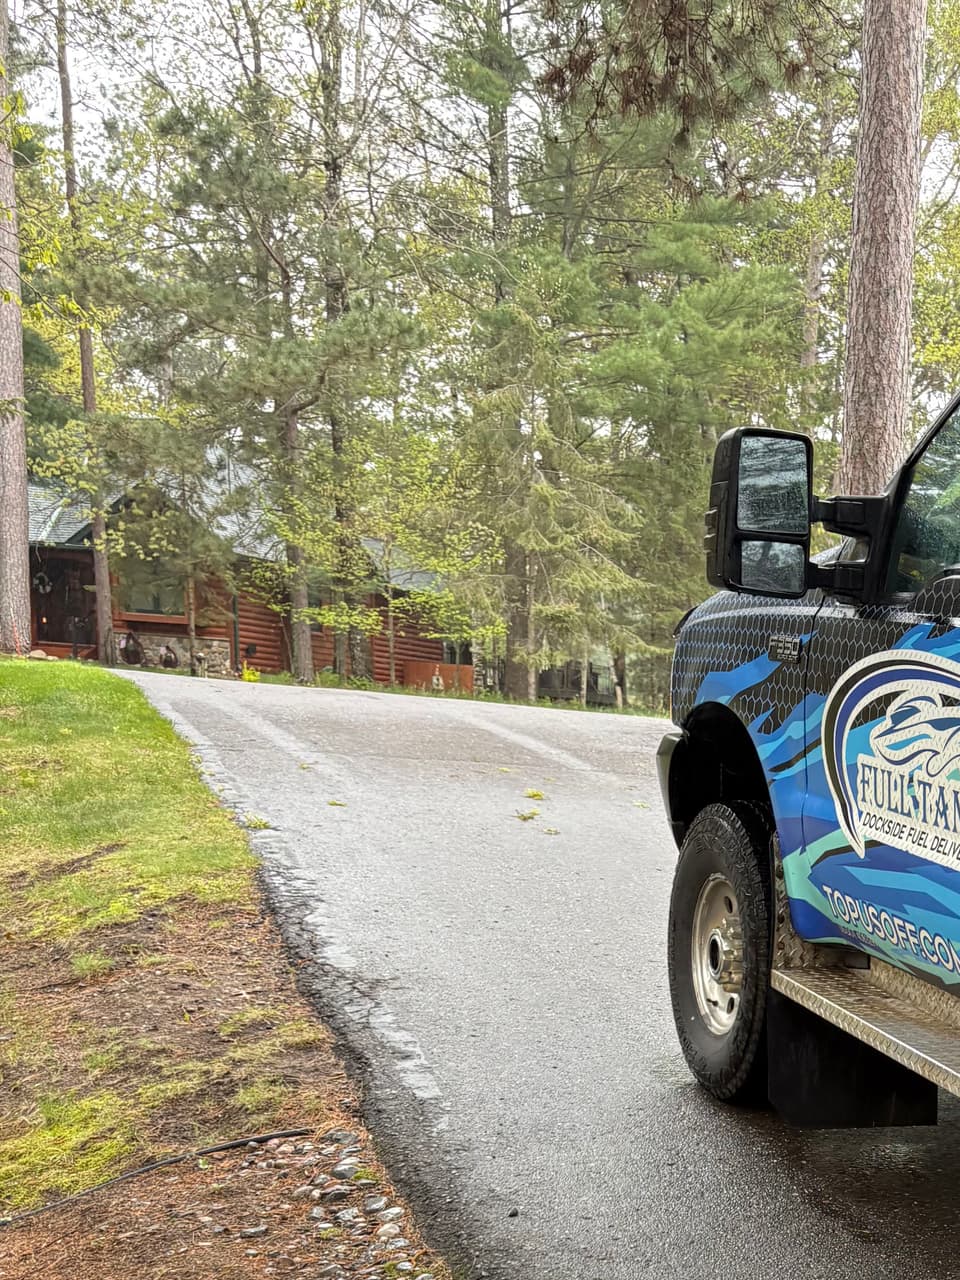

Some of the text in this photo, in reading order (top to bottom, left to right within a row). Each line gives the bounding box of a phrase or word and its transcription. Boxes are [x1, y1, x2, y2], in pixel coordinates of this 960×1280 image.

[860, 762, 912, 819] FULL
[862, 812, 907, 840] DOCKSIDE
[906, 827, 929, 849] FUEL
